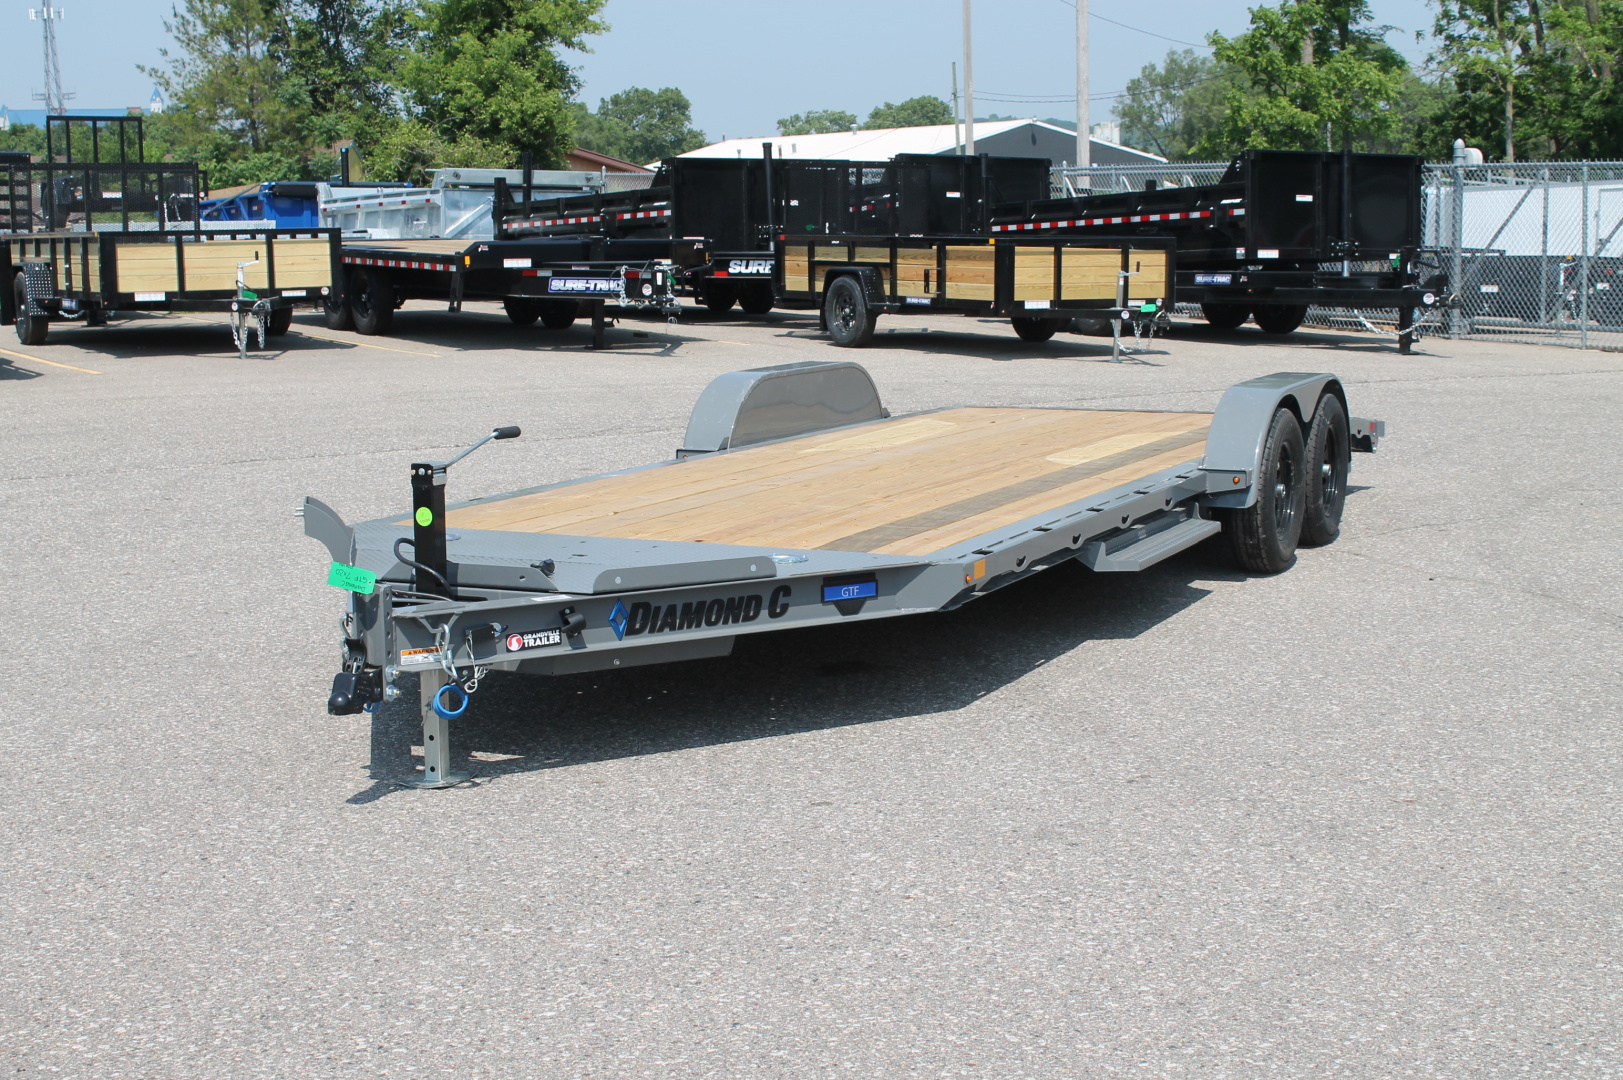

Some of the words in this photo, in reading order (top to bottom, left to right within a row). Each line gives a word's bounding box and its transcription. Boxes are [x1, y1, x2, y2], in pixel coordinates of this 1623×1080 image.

[550, 279, 624, 291] SURE-TRAC
[841, 586, 860, 597] GTF
[625, 594, 762, 636] DIAMOND
[768, 585, 791, 619] C
[523, 630, 560, 643] GRANDVILLE
[523, 636, 561, 648] TRAILER
